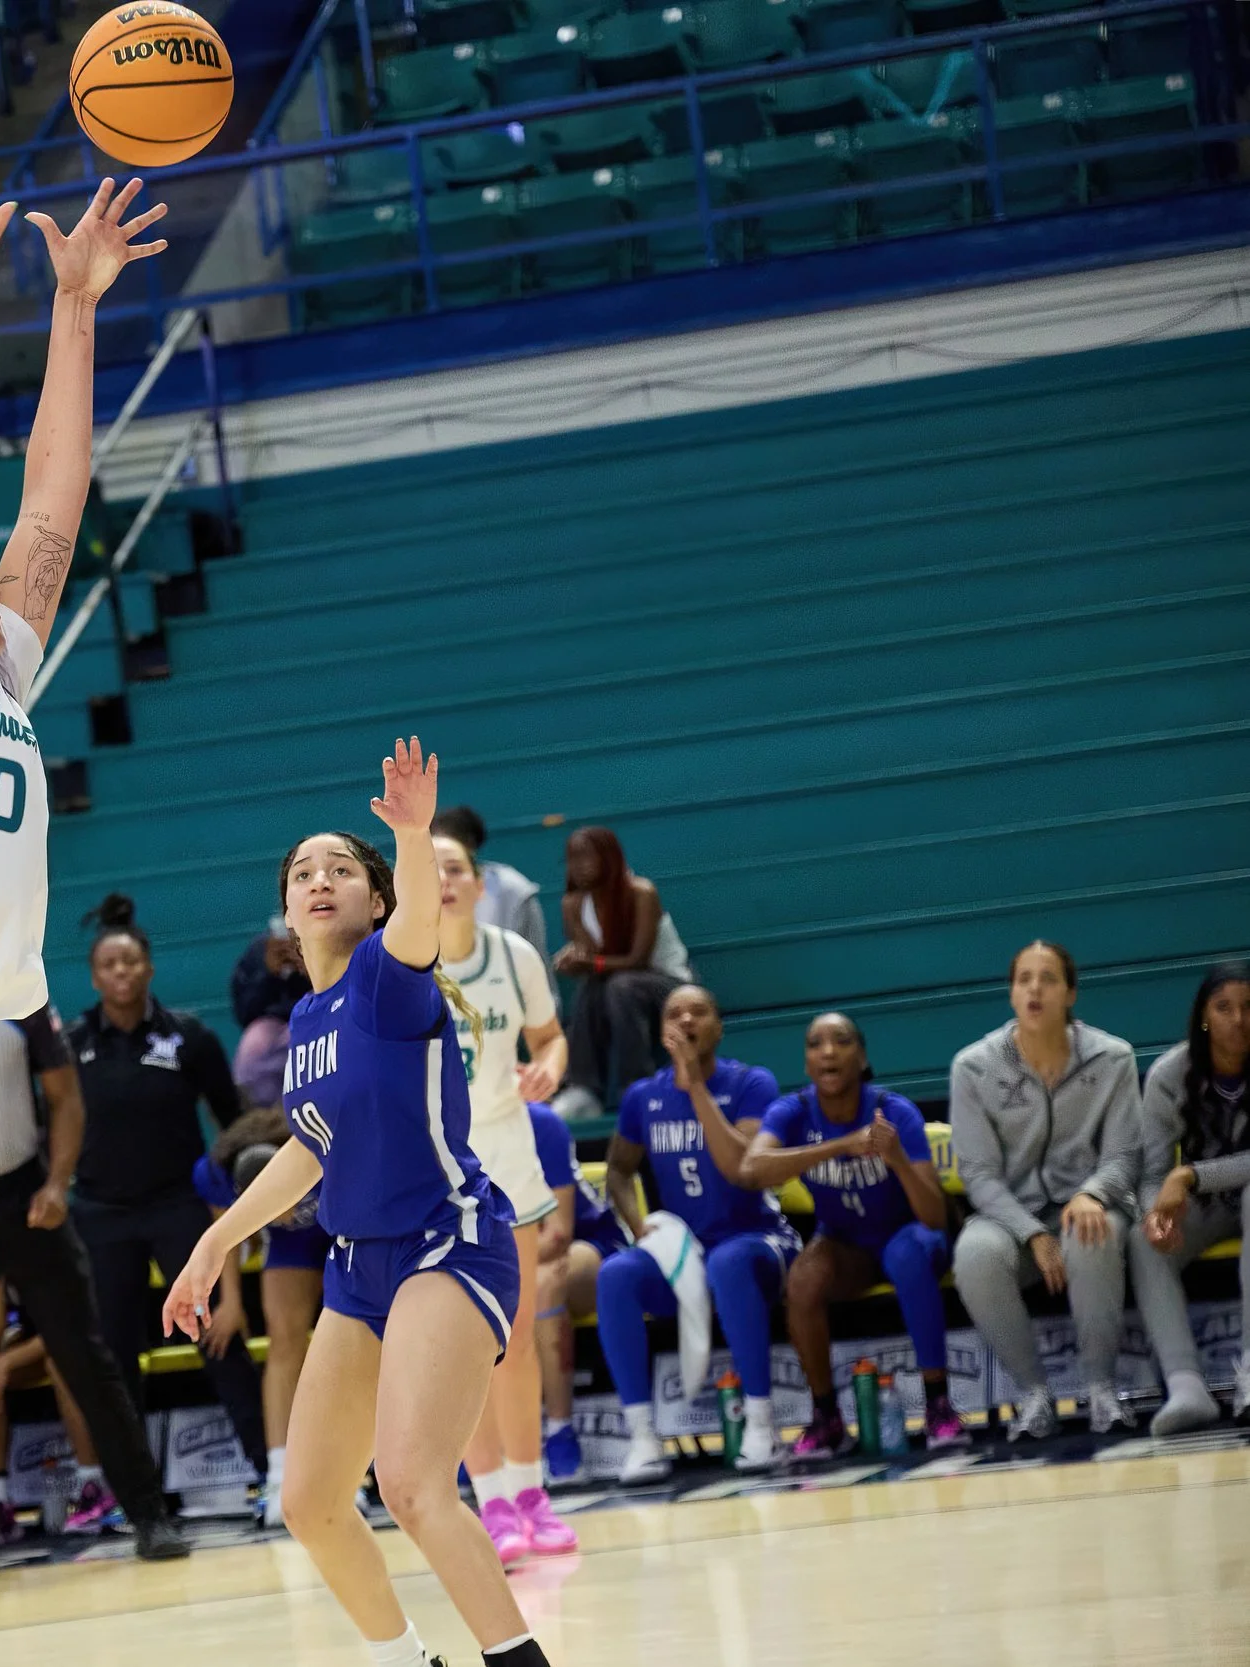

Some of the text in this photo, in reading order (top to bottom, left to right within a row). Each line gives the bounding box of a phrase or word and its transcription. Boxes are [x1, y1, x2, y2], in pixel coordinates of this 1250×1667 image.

[111, 37, 222, 69] Wilson
[282, 1029, 338, 1096] MPTON
[291, 1101, 334, 1157] 10
[678, 1157, 704, 1197] 5
